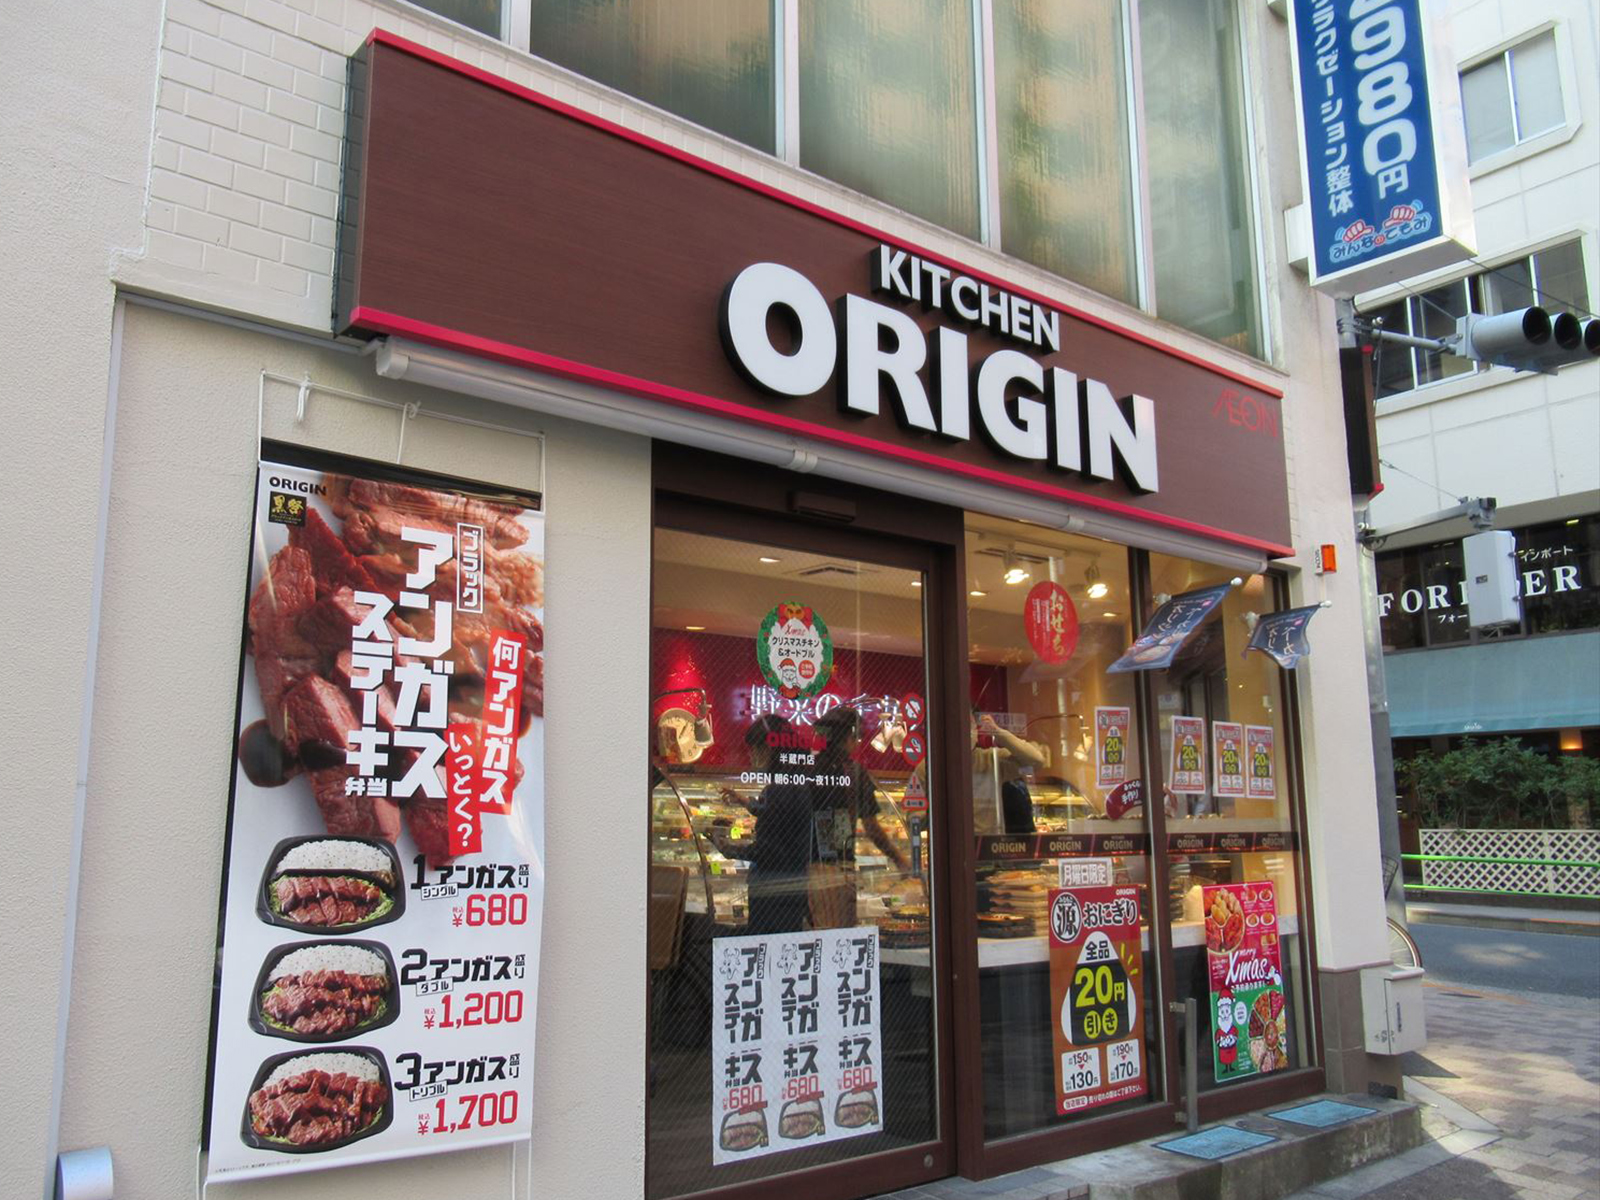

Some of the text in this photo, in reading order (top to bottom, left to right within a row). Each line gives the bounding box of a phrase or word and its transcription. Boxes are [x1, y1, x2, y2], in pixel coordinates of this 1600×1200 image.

[1349, 0, 1417, 200] 980円
[877, 244, 1060, 352] KITCHEN
[725, 262, 1160, 494] ORIGIN
[269, 476, 326, 496] ORIGIN
[462, 529, 479, 608] ブラック
[1378, 565, 1582, 617] FORER
[772, 637, 820, 648] クリスマスチキン
[391, 526, 455, 799] アンガス
[345, 591, 394, 776] ステーキ
[479, 636, 522, 804] 何アンガス
[779, 753, 816, 765] 半蔵門店
[345, 777, 388, 797] 弁当
[740, 772, 772, 785] OPEN
[991, 842, 1026, 853] ORIGIN
[1049, 840, 1082, 851] ORIGIN
[1103, 839, 1133, 850] ORIGIN
[1063, 863, 1106, 886] 月曜日限定
[423, 886, 456, 898] シングル
[1115, 888, 1136, 896] ORIGIN
[1083, 897, 1137, 928] おにぎり
[1085, 941, 1110, 961] 全品
[1225, 951, 1268, 985] Xmas
[420, 981, 450, 993] ダブル
[798, 942, 819, 1076] アンガス
[852, 938, 872, 1067] アンガス
[741, 948, 764, 1086] アンガス
[781, 977, 798, 1069] ステーキ
[837, 972, 852, 1060] ステーキ
[1086, 1012, 1116, 1035] 引き
[725, 983, 740, 1078] ステーキ
[788, 1075, 818, 1099] 680
[843, 1066, 872, 1090] 680
[412, 1084, 446, 1098] トリプル
[729, 1084, 763, 1110] 680
